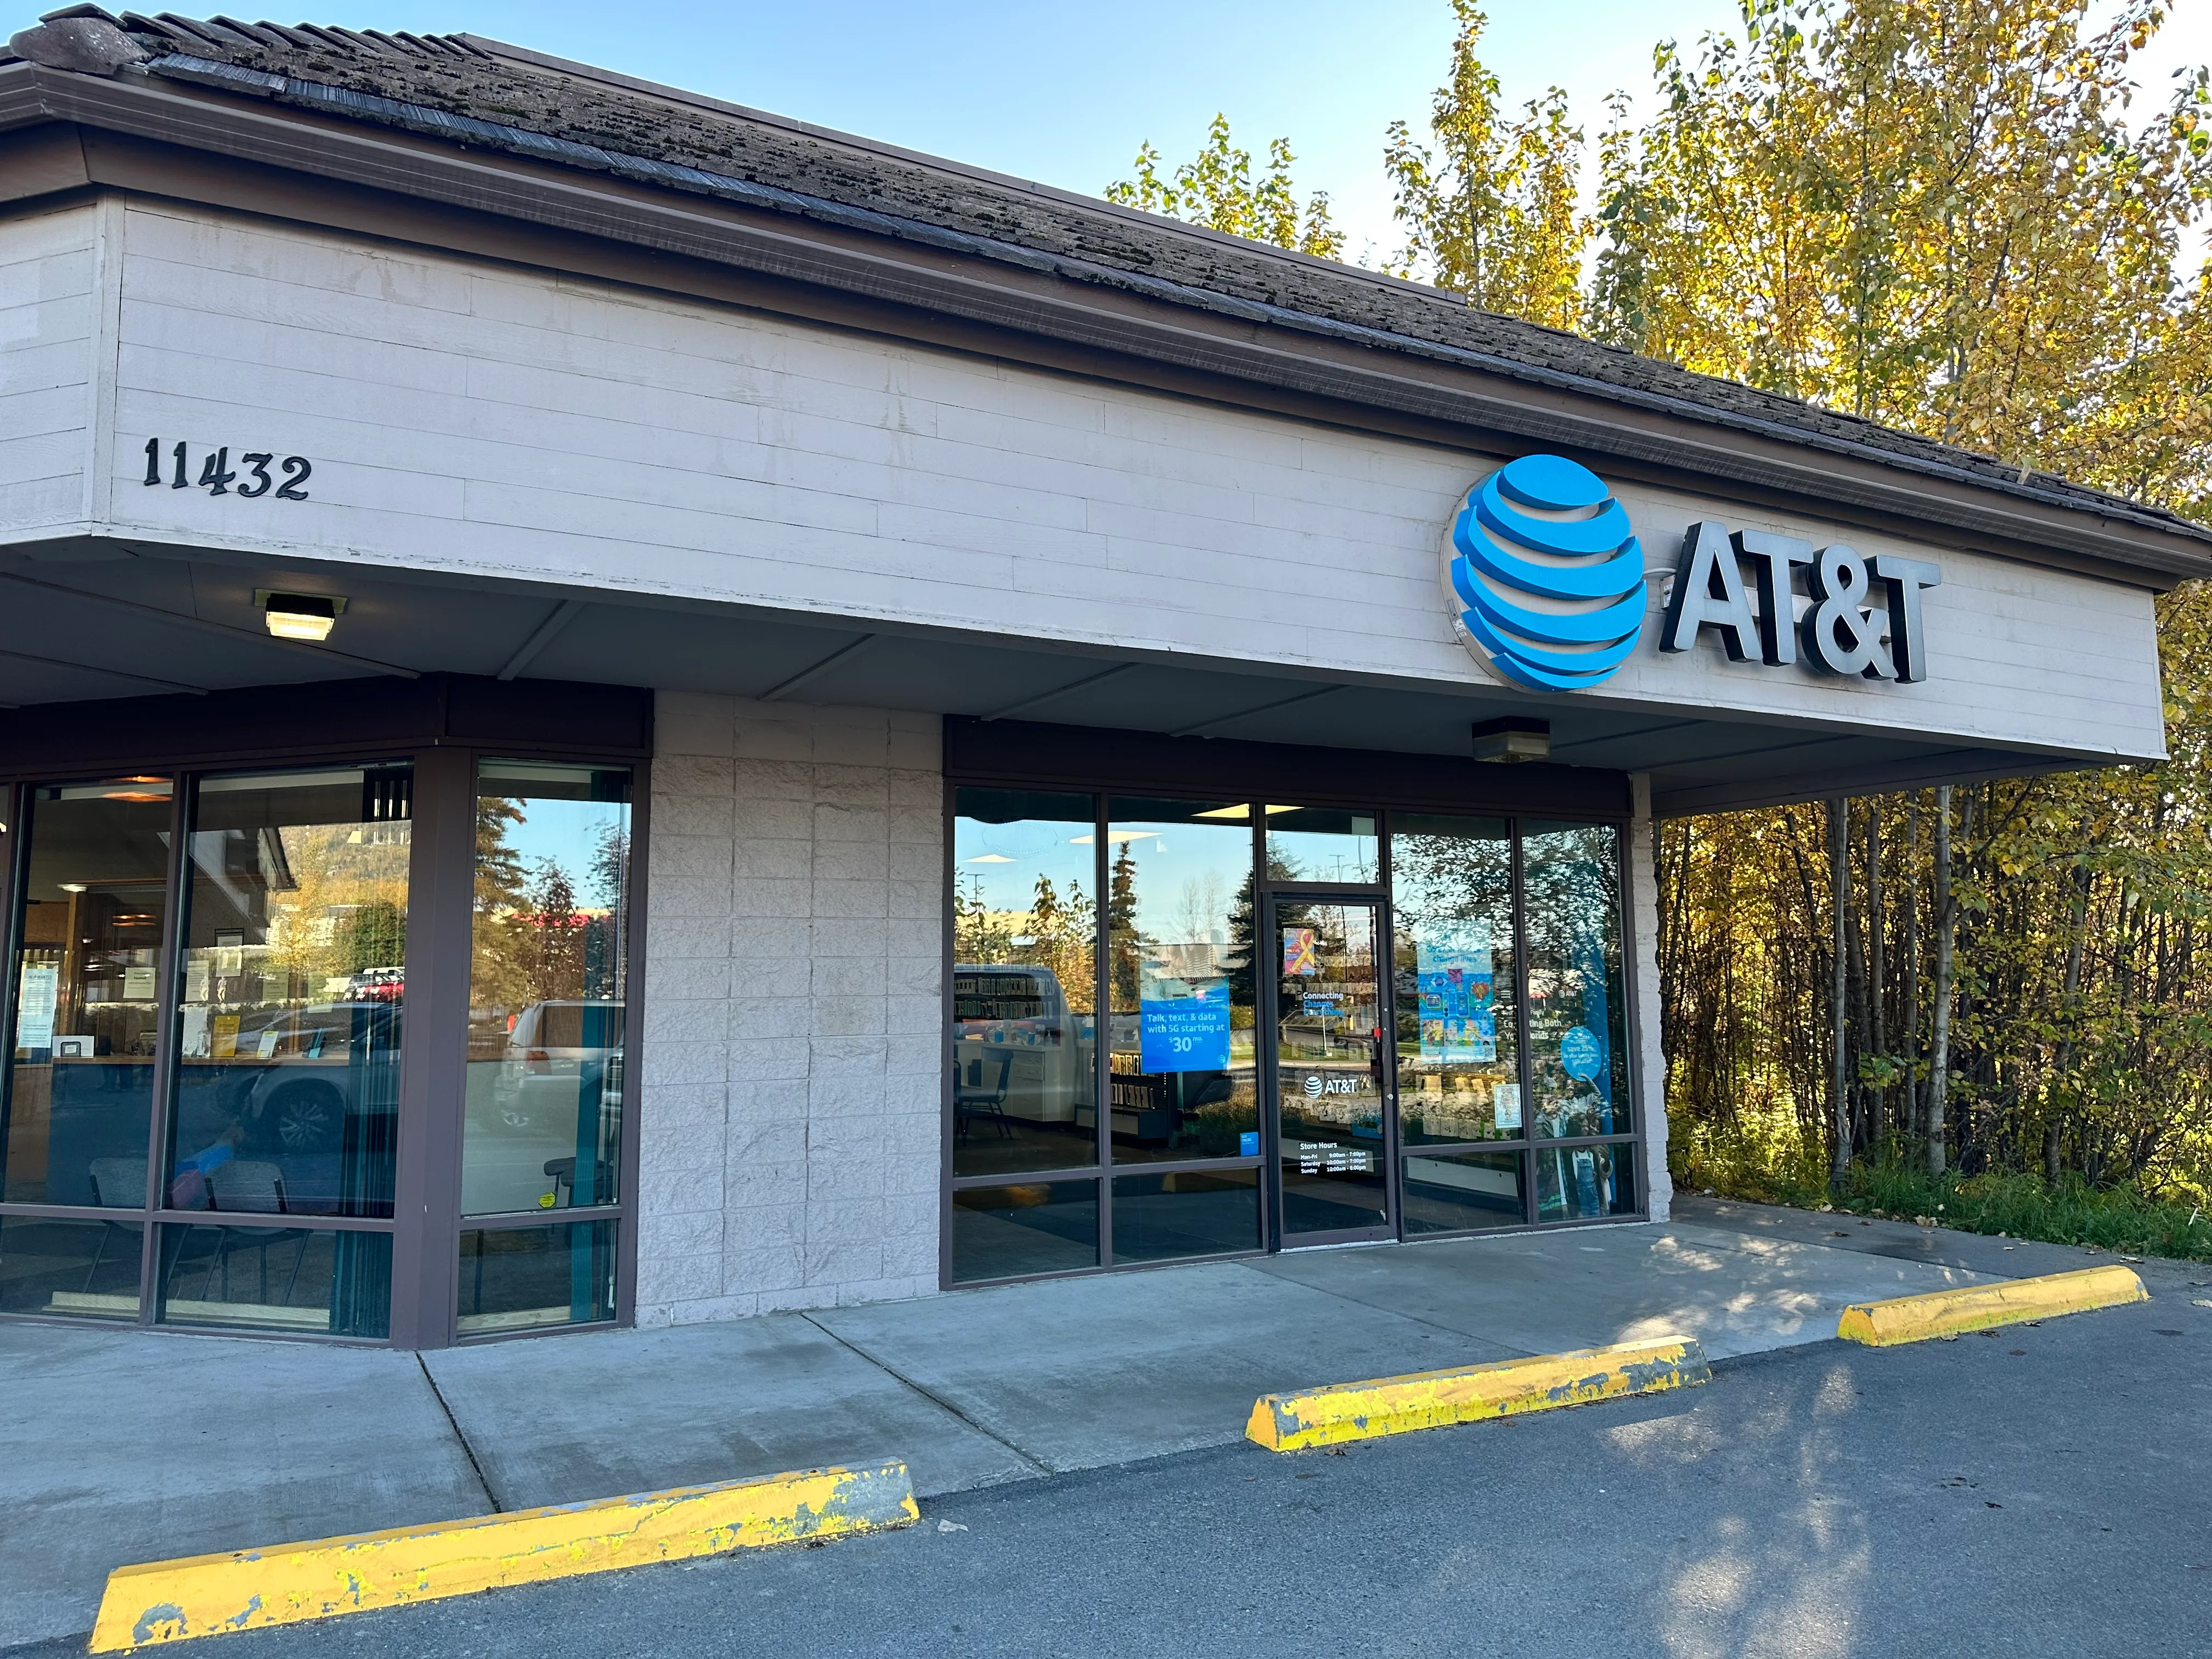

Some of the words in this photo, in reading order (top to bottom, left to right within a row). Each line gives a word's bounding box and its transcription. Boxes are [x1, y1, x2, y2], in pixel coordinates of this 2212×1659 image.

[144, 437, 312, 500] 11432
[1658, 521, 1940, 684] AT&T
[1302, 991, 1344, 1001] Connecting
[1303, 1000, 1334, 1009] Changes
[1147, 1013, 1167, 1023] Talk,
[1168, 1014, 1188, 1023] text,
[1190, 1013, 1197, 1021] &
[1198, 1013, 1217, 1021] data
[1544, 1018, 1562, 1028] Both
[1147, 1024, 1167, 1033] with
[1168, 1024, 1179, 1032] 5G
[1181, 1023, 1215, 1033] starting
[1216, 1023, 1225, 1031] at
[1169, 1036, 1192, 1052] $30
[1325, 1079, 1357, 1094] AT&T
